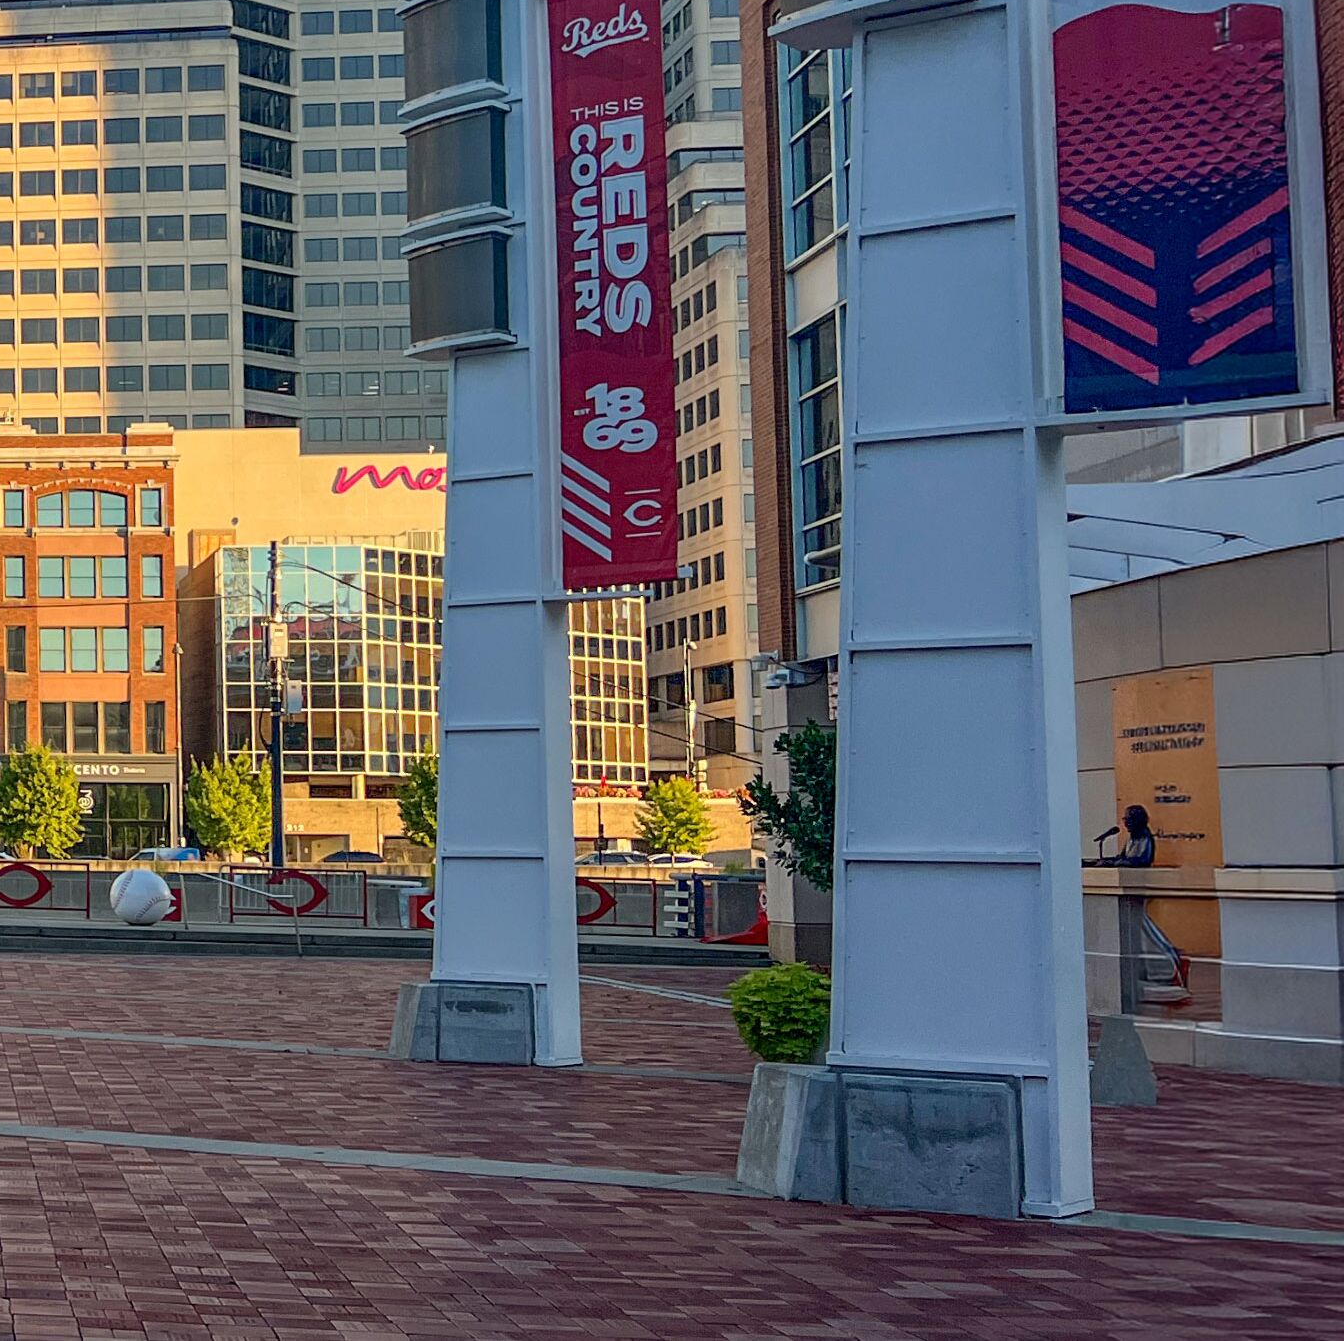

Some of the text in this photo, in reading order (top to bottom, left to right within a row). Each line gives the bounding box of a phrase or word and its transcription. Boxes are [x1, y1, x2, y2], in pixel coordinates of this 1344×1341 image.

[561, 3, 648, 58] Reds
[570, 96, 644, 121] THIS IS
[569, 123, 602, 337] COUNTRY
[600, 115, 652, 334] REDS
